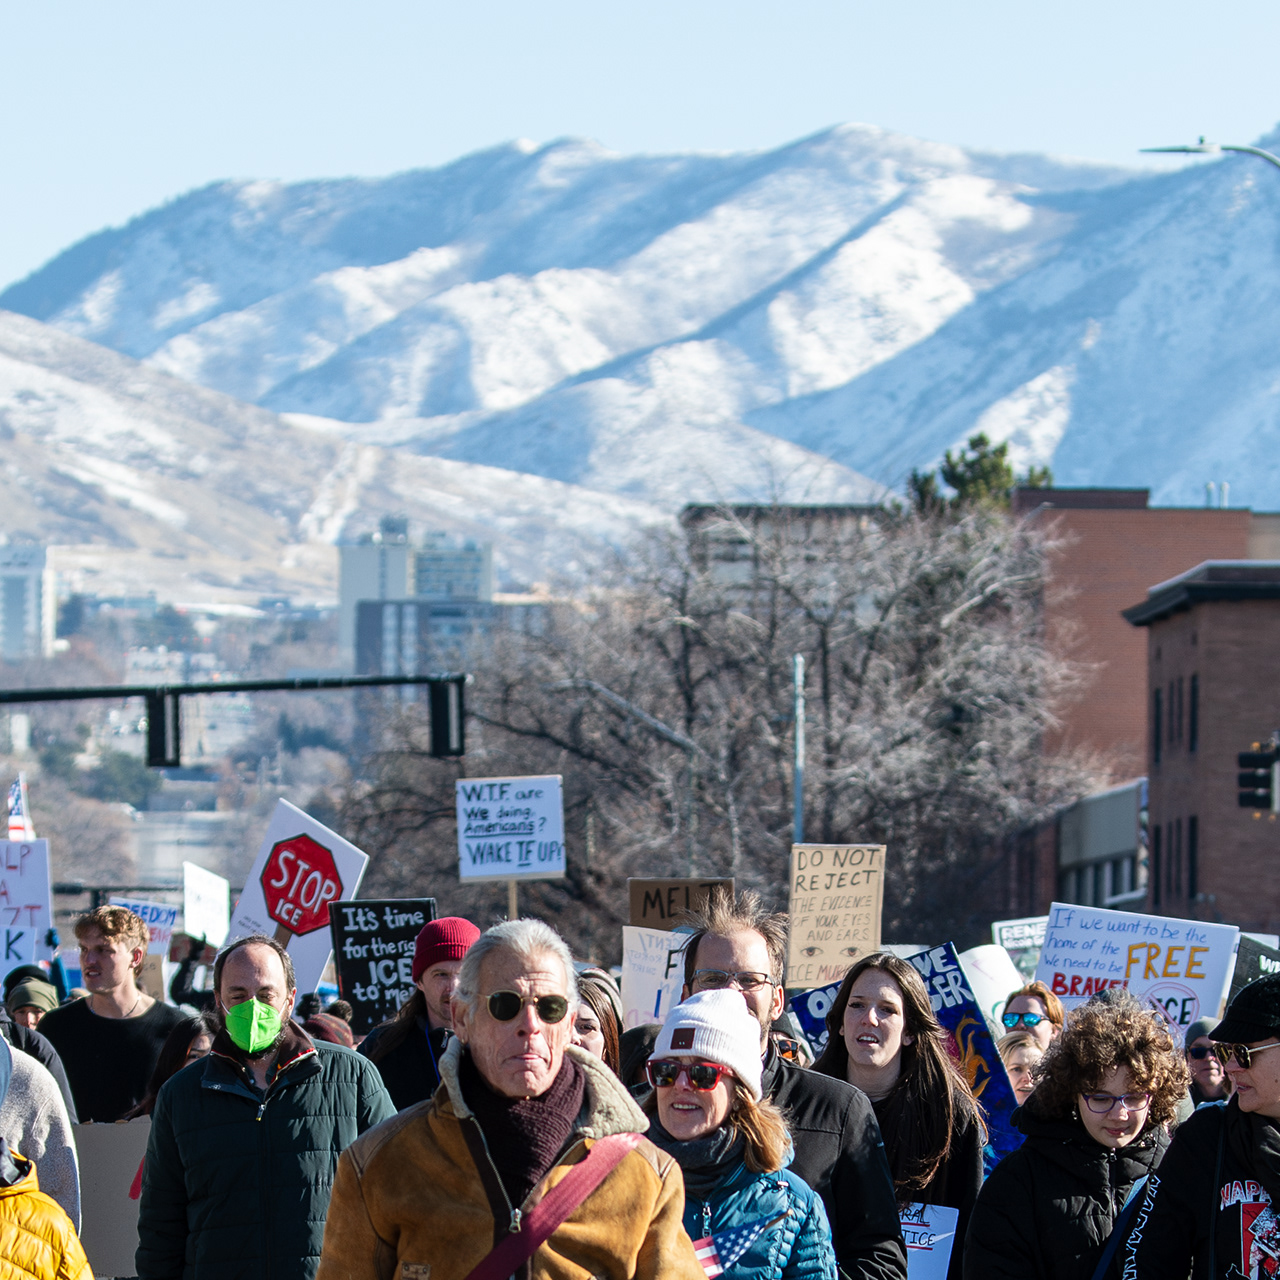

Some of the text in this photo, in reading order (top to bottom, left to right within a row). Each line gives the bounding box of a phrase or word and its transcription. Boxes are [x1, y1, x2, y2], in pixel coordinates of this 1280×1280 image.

[515, 789, 544, 800] are
[463, 807, 489, 819] We
[466, 842, 512, 865] WAKE
[798, 849, 880, 871] DO NOT
[271, 850, 336, 914] STOP
[795, 870, 877, 893] REJECT
[642, 882, 723, 919] MELT
[792, 896, 873, 913] THE EVIDENCE
[274, 898, 303, 926] ICE
[341, 907, 425, 932] It's time
[794, 913, 870, 928] OF YOUR EYES
[807, 928, 869, 941] AND EARS
[1050, 908, 1207, 943] If we want to be the
[343, 935, 418, 960] for the rig
[1046, 933, 1079, 949] home
[1082, 934, 1097, 950] of
[1101, 939, 1120, 955] the
[368, 957, 413, 987] ICE
[1063, 957, 1091, 971] need
[1094, 958, 1106, 972] to
[1109, 958, 1123, 973] be
[1125, 942, 1209, 980] FREE
[787, 964, 814, 983] ICE
[1052, 972, 1128, 996] BRAVE!
[353, 981, 379, 1001] to
[902, 1206, 930, 1225] RAL
[902, 1229, 936, 1246] TICE
